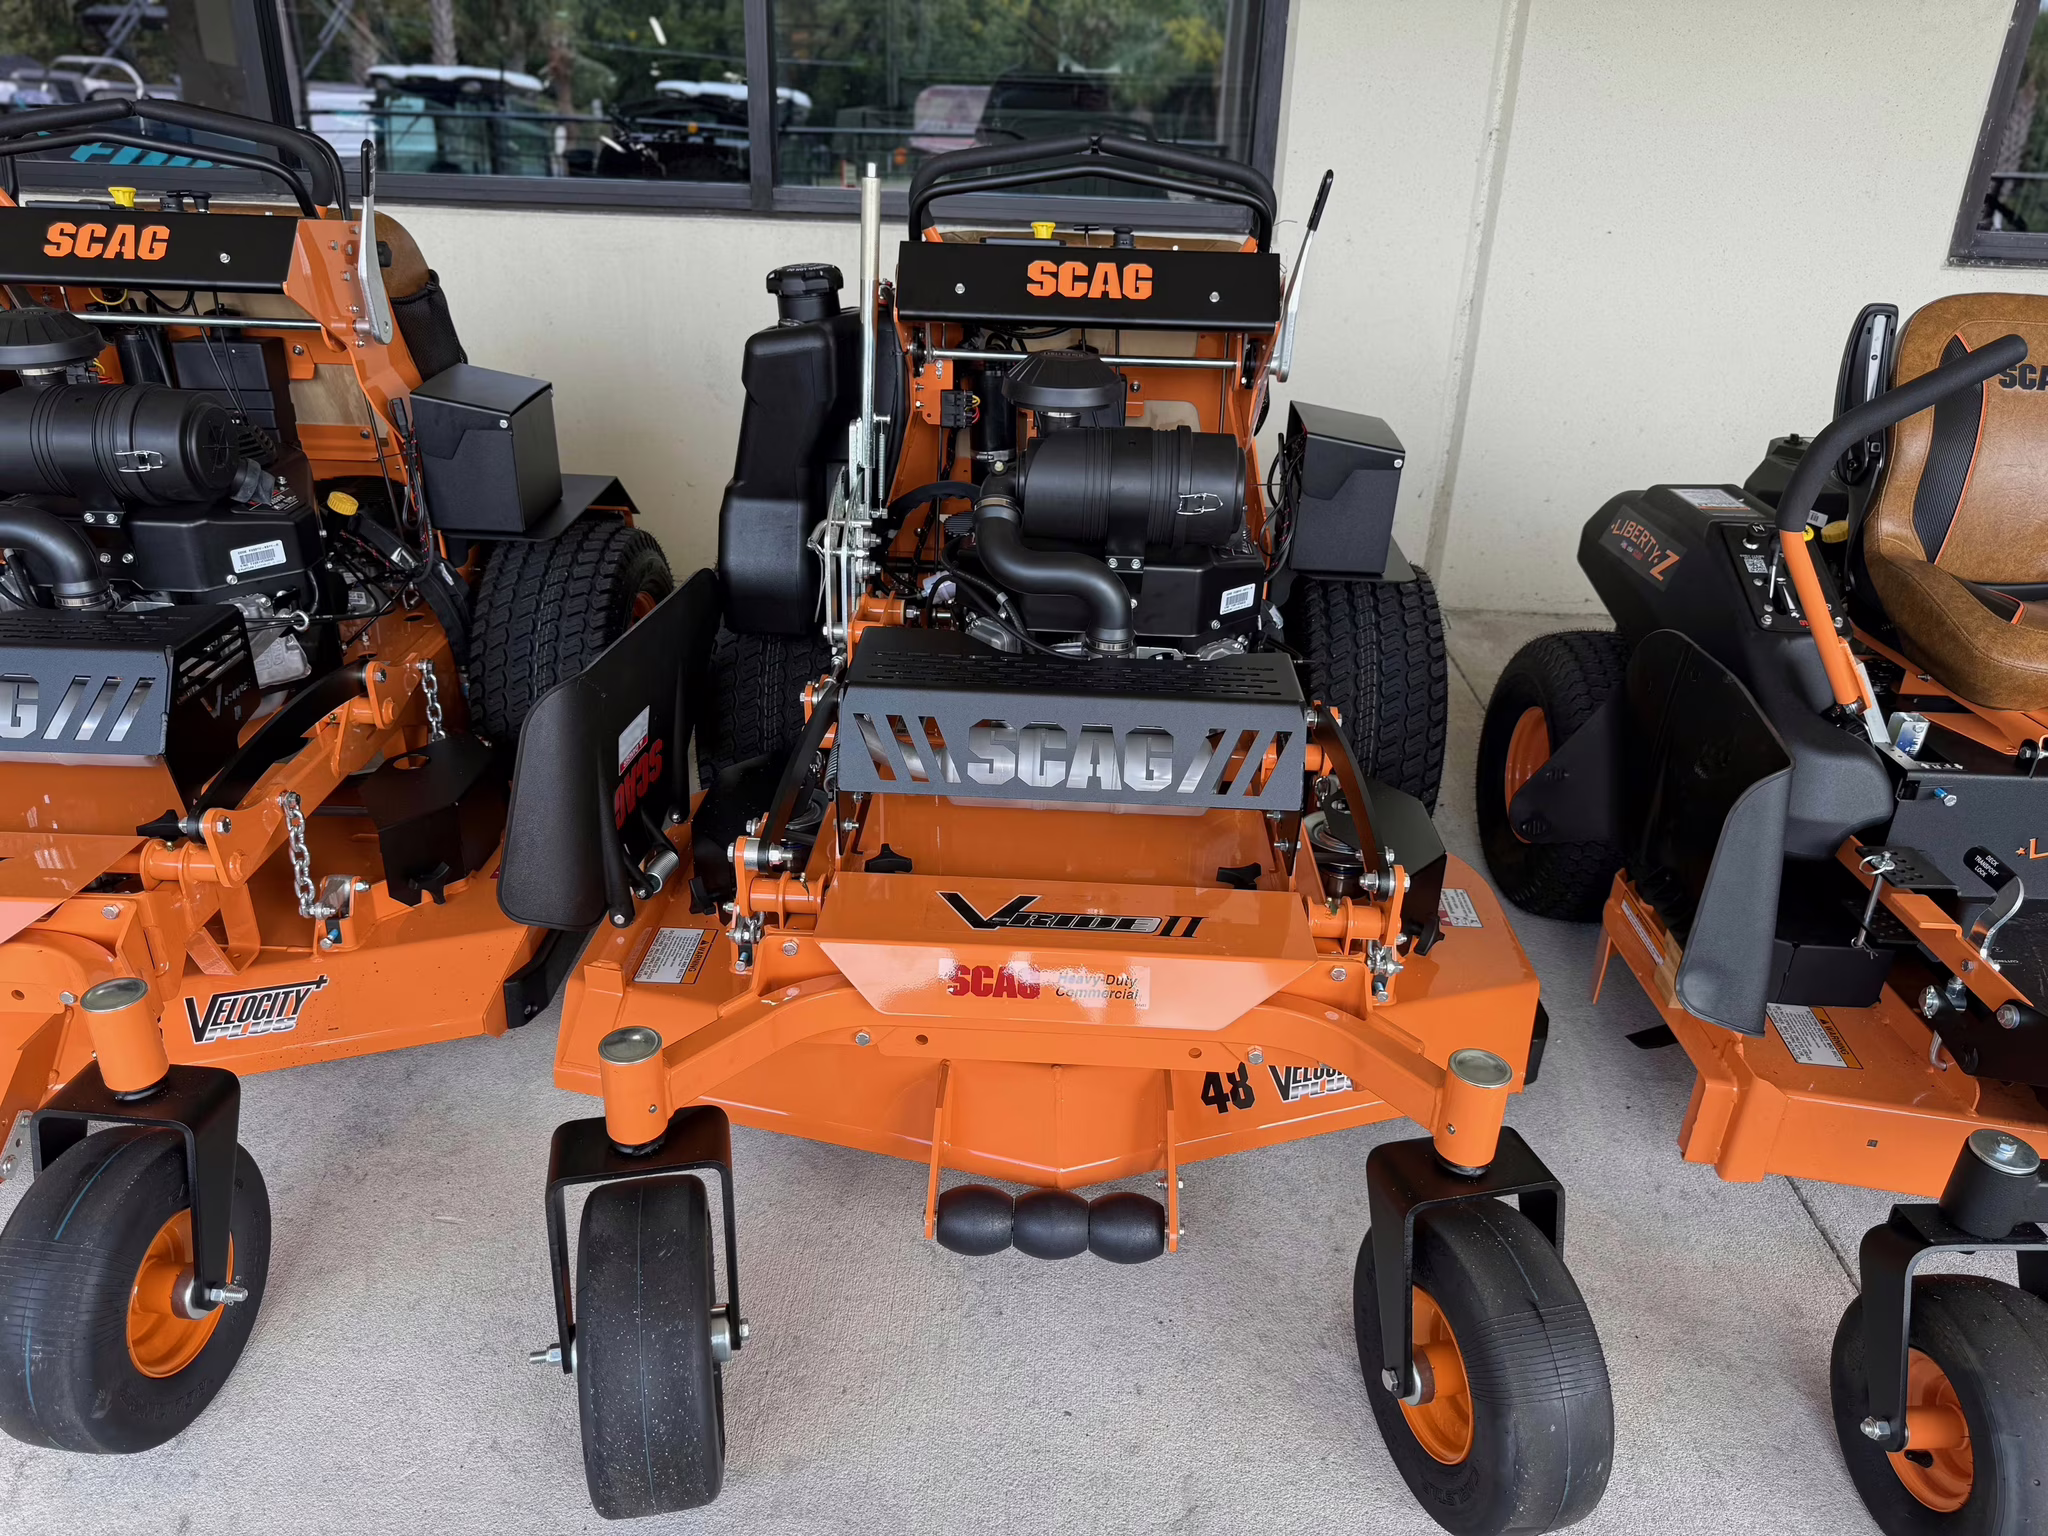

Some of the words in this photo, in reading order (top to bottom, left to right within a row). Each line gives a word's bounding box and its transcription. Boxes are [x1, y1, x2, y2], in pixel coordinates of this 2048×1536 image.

[43, 222, 170, 261] SCAG
[1026, 260, 1153, 300] SCAG
[1612, 518, 1661, 563] LIBERTY
[1649, 549, 1681, 582] Z
[967, 719, 1174, 792] SCAG
[614, 739, 664, 830] SCAG
[1974, 855, 1999, 877] TRANSPORT
[1974, 865, 1988, 877] LOCK
[1985, 855, 1999, 867] DECK
[1153, 915, 1209, 938] II
[687, 945, 707, 972] WARNING
[948, 965, 1041, 999] SCAG
[1058, 971, 1137, 989] Heavy-Duty
[1056, 986, 1140, 1001] Commercial
[204, 1017, 297, 1042] PLUS
[1825, 1025, 1850, 1055] WARNING
[1201, 1062, 1255, 1114] 48
